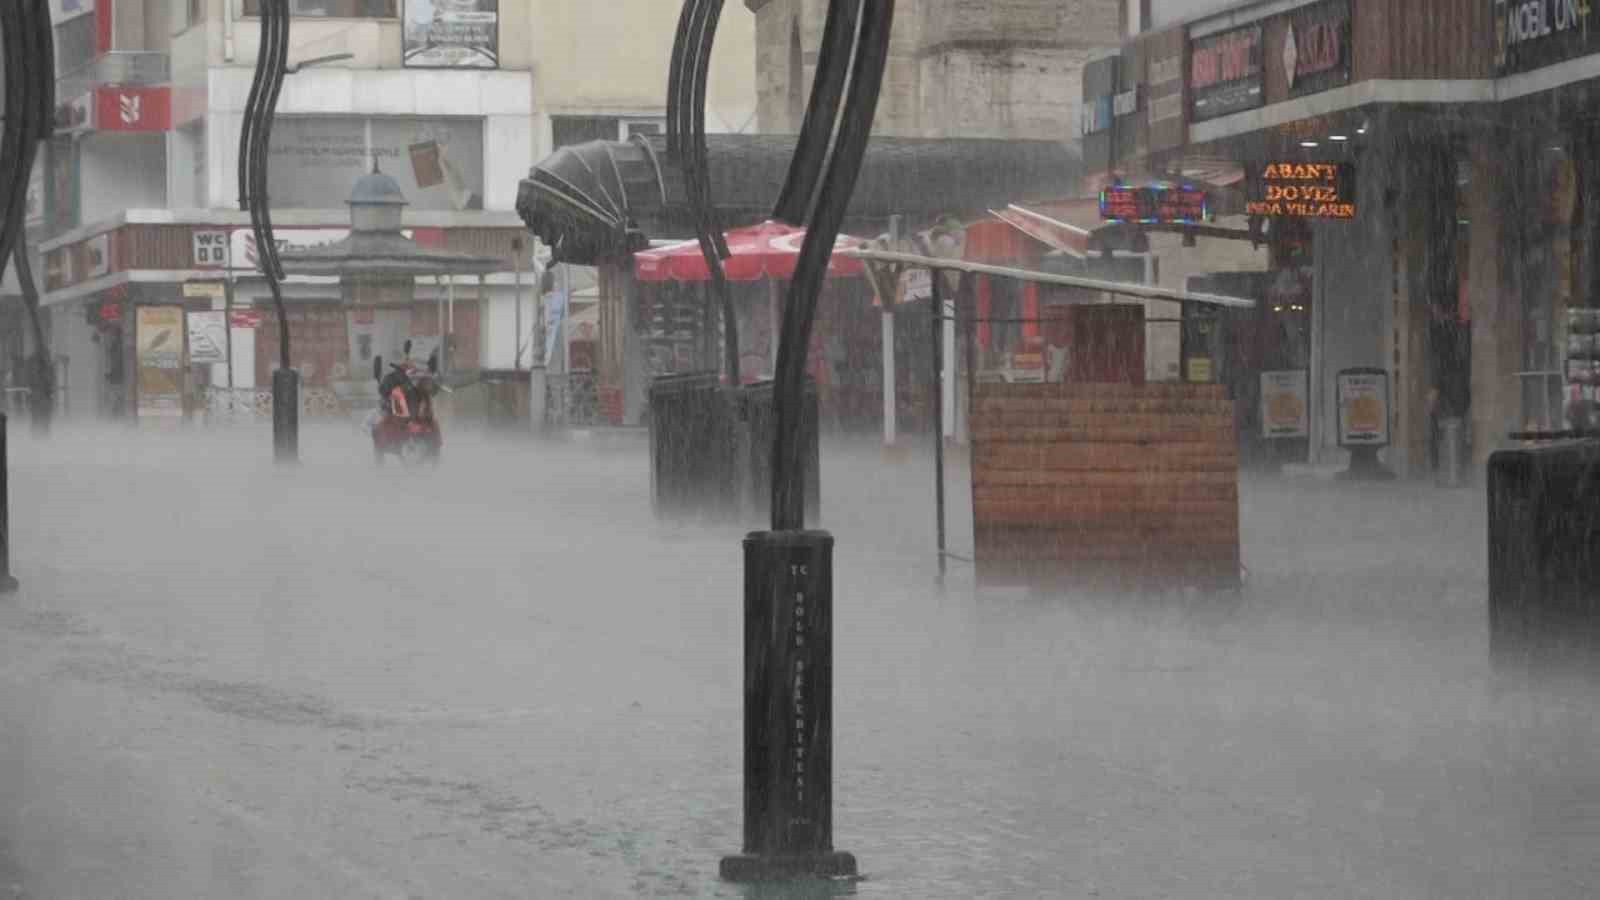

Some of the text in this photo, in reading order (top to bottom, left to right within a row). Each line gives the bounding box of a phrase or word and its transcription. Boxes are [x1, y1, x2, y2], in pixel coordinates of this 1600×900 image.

[1264, 163, 1337, 179] ABANT
[196, 233, 225, 247] WC
[791, 564, 808, 576] TC
